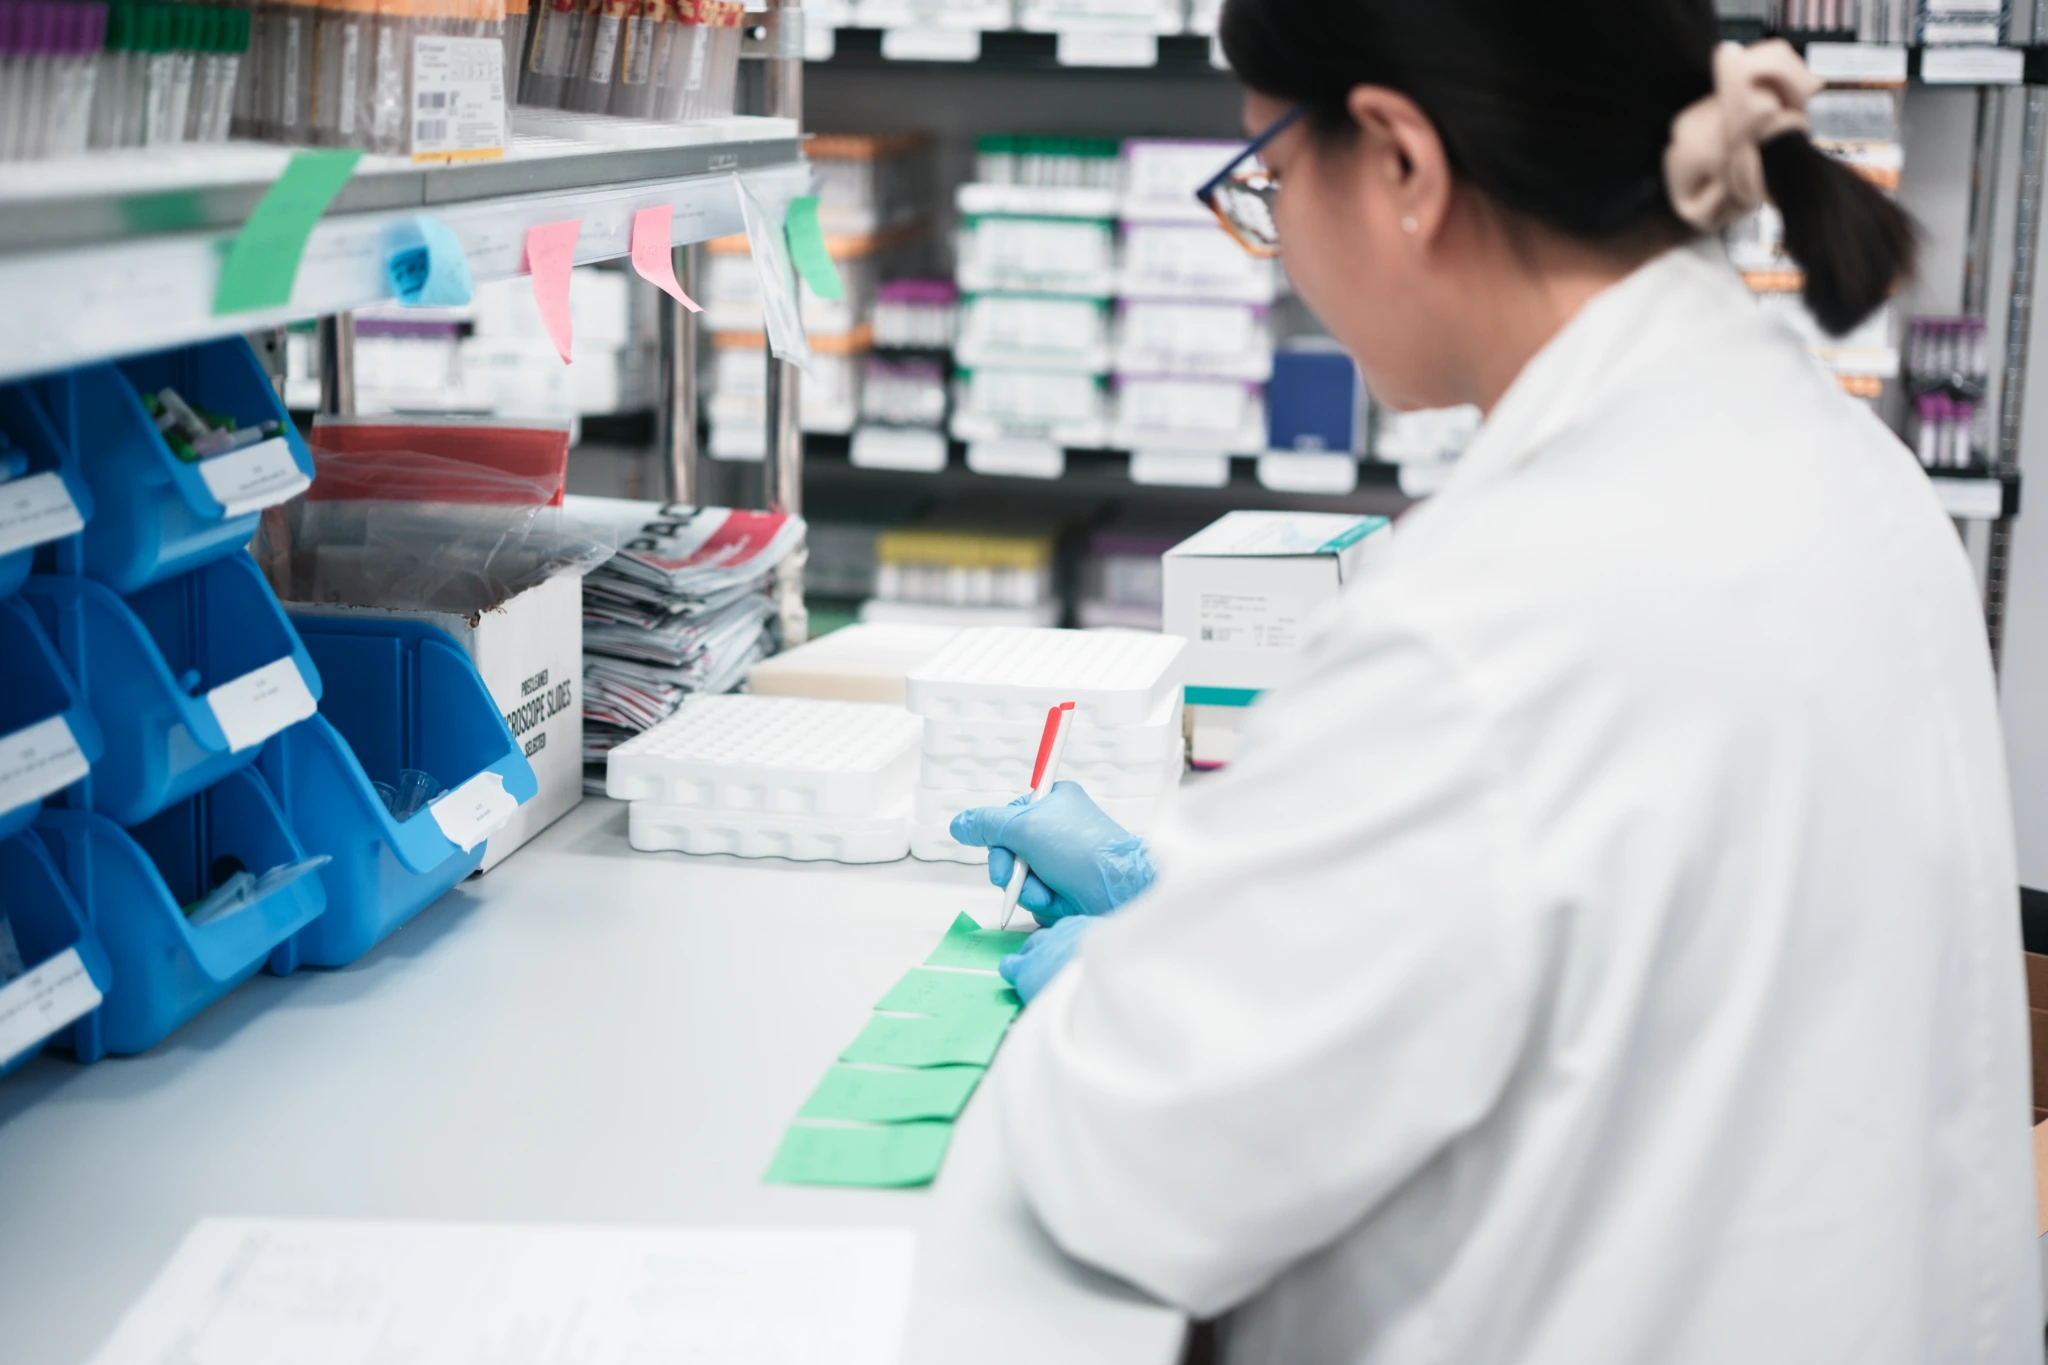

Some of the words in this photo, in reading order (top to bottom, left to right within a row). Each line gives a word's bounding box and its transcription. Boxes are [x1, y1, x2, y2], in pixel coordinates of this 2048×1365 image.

[521, 668, 549, 698] PRECLEANED
[504, 694, 545, 739] CROSCOPE
[547, 678, 572, 719] SLIDES
[525, 732, 546, 758] SELECTED
